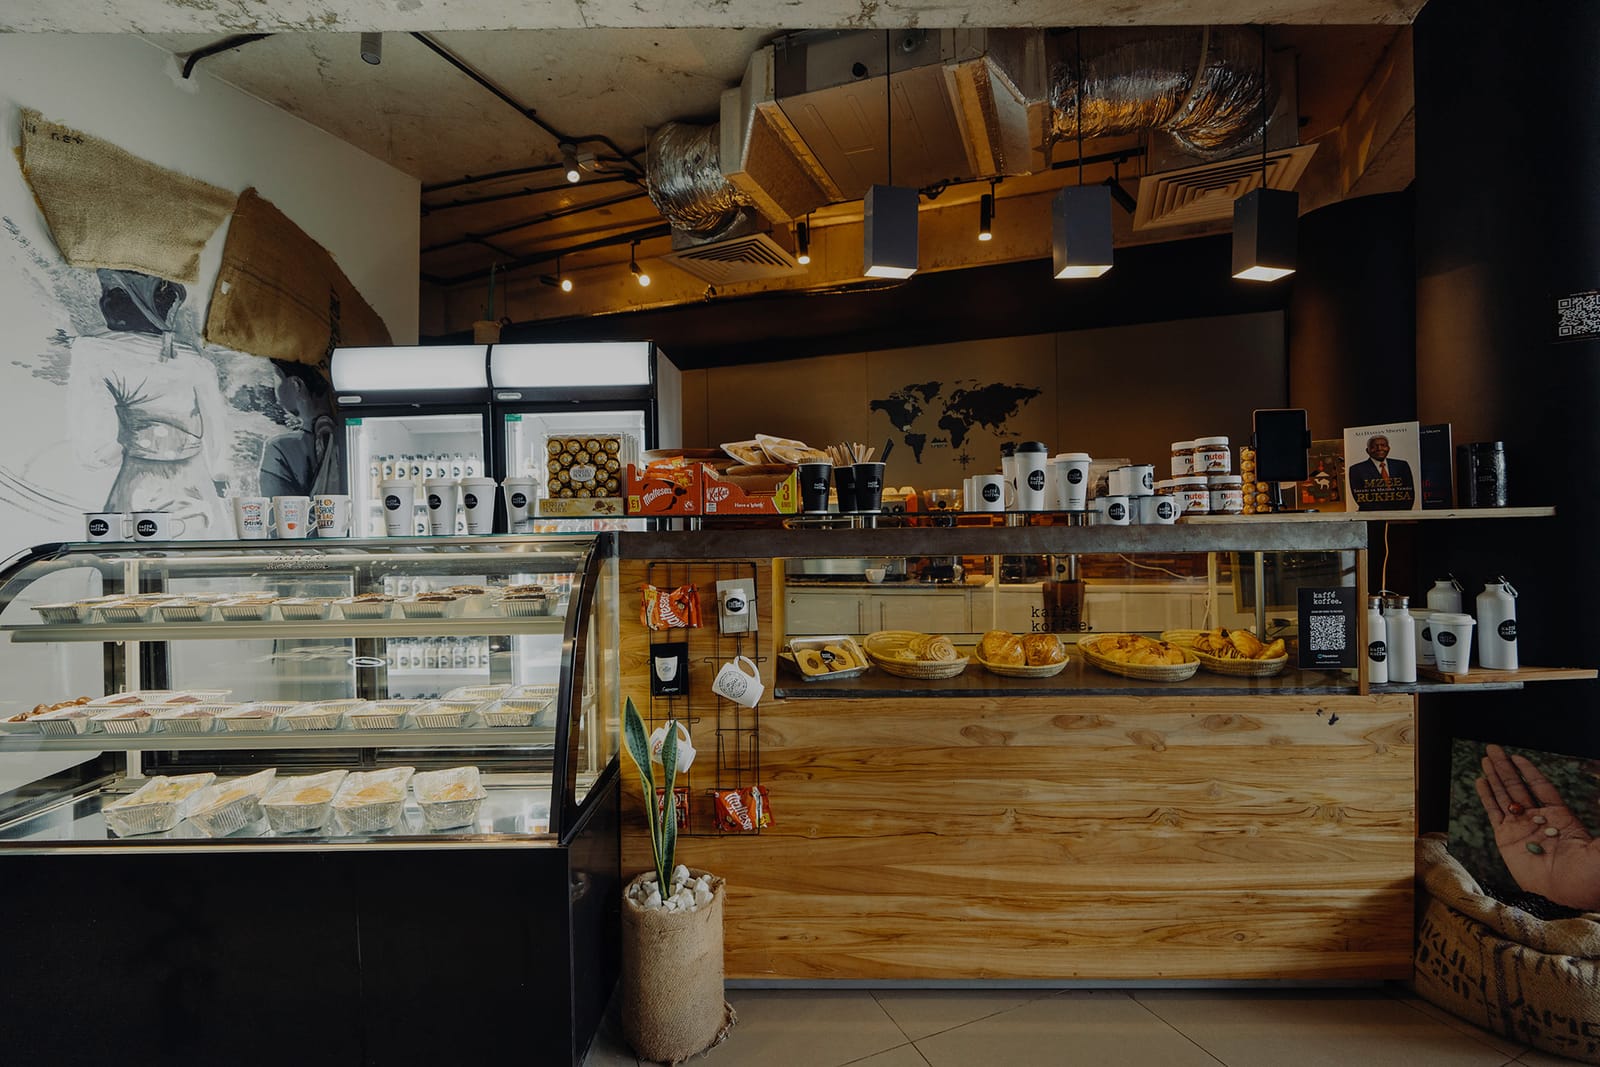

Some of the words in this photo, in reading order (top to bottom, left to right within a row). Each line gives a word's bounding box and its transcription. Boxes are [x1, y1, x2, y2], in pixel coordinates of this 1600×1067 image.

[1364, 477, 1403, 488] MZEE
[782, 484, 790, 501] 3
[1357, 491, 1413, 503] RUKHSA
[1313, 591, 1336, 599] kaffé
